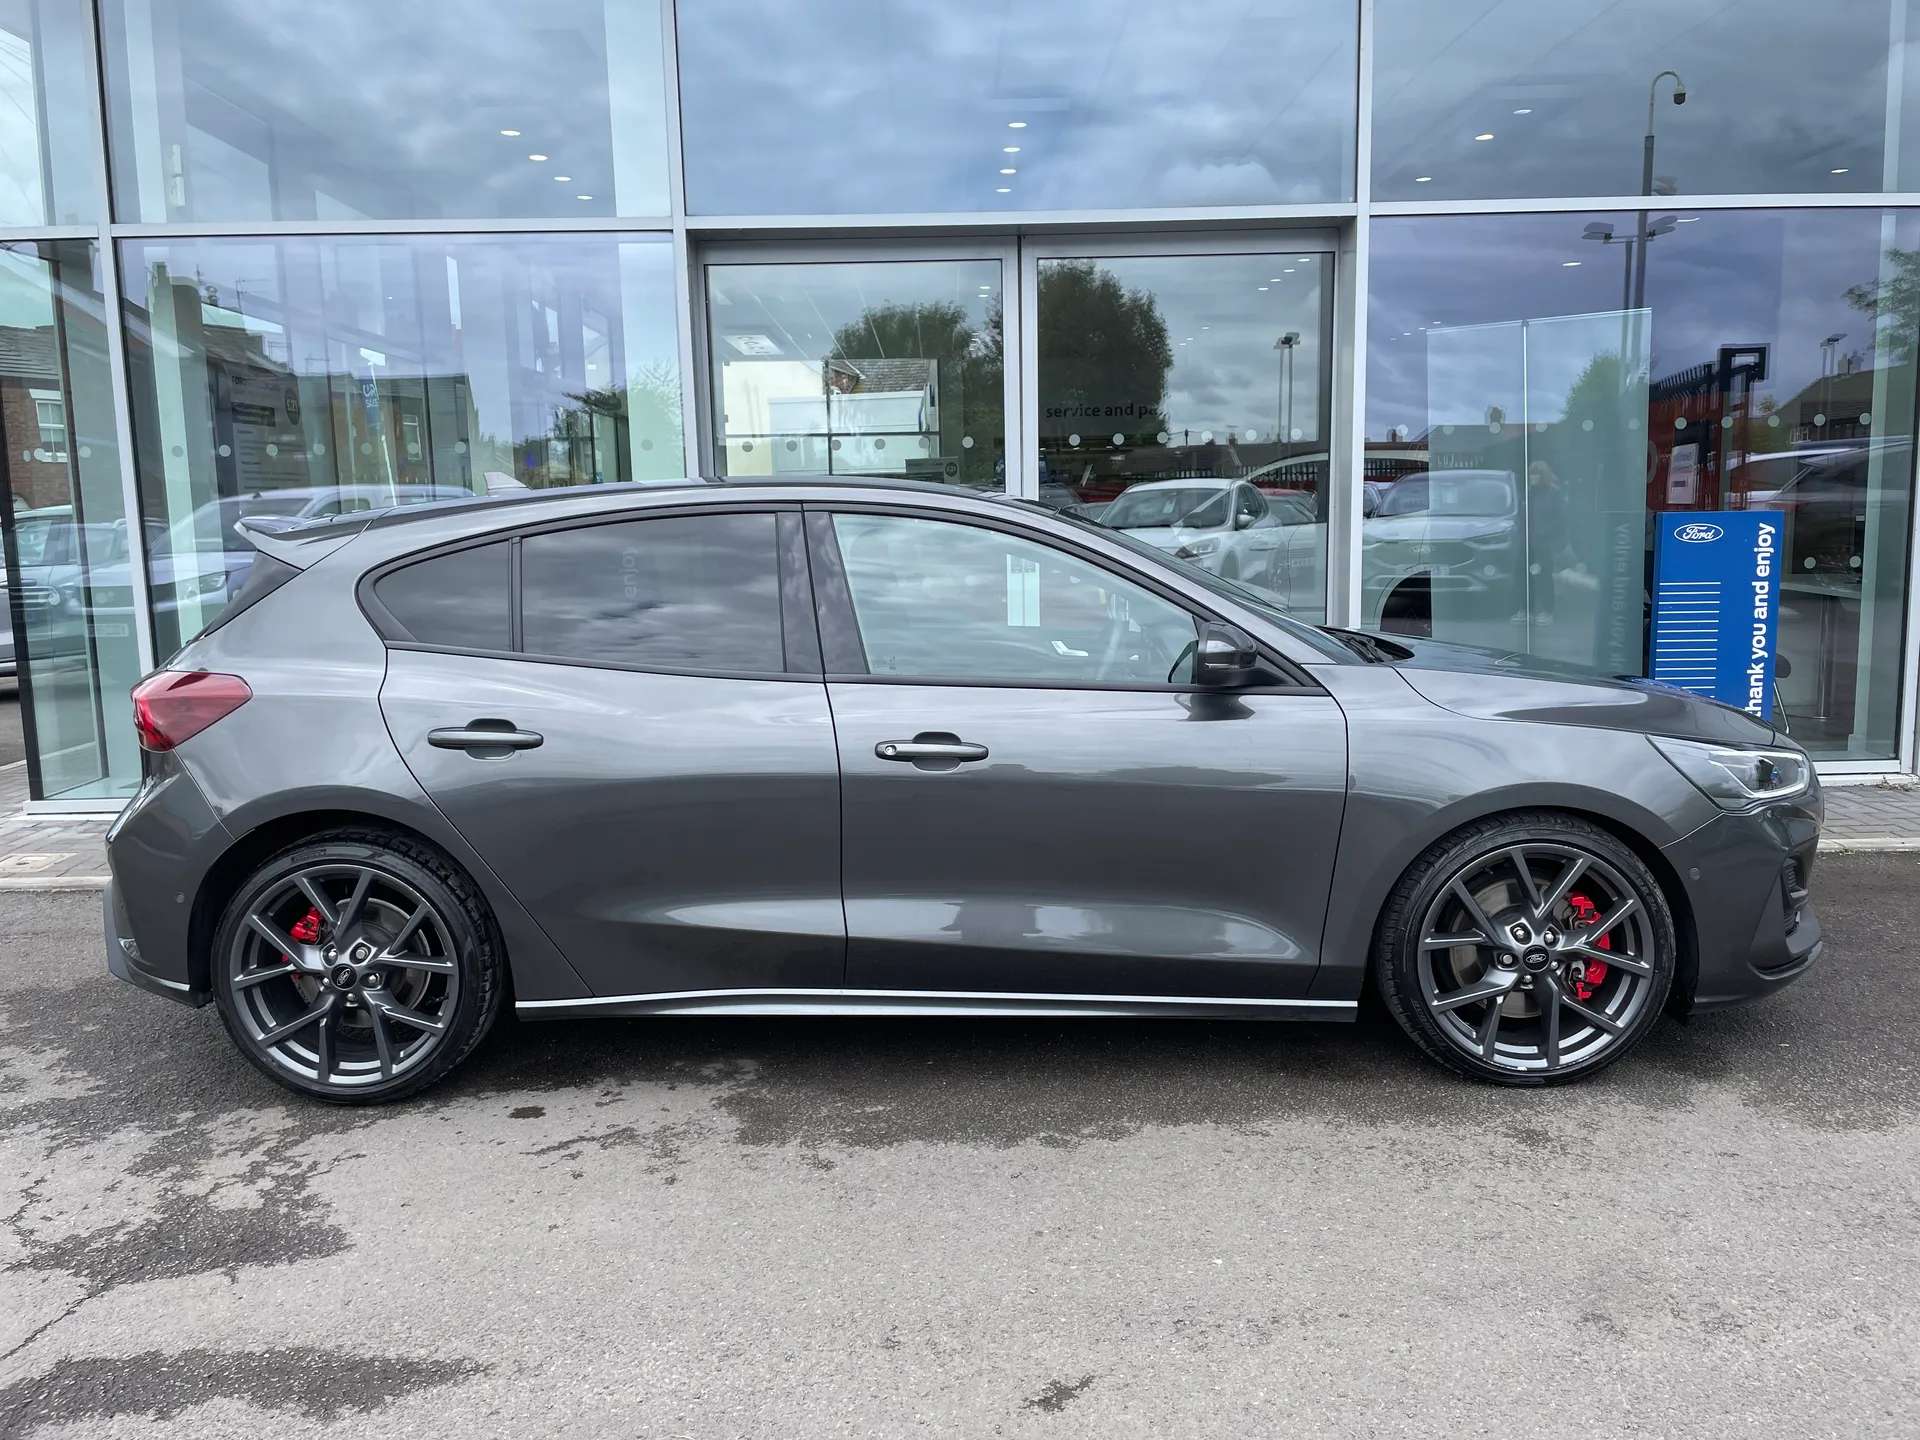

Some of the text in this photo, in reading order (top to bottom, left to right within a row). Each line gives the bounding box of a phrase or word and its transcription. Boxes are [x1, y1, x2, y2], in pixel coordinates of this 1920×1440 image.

[1045, 403, 1101, 419] service
[1104, 402, 1135, 417] and
[1682, 525, 1717, 540] Ford
[1753, 522, 1776, 578] enjoy
[620, 546, 641, 600] enjoy
[1752, 581, 1770, 620] and
[1751, 623, 1769, 660] you
